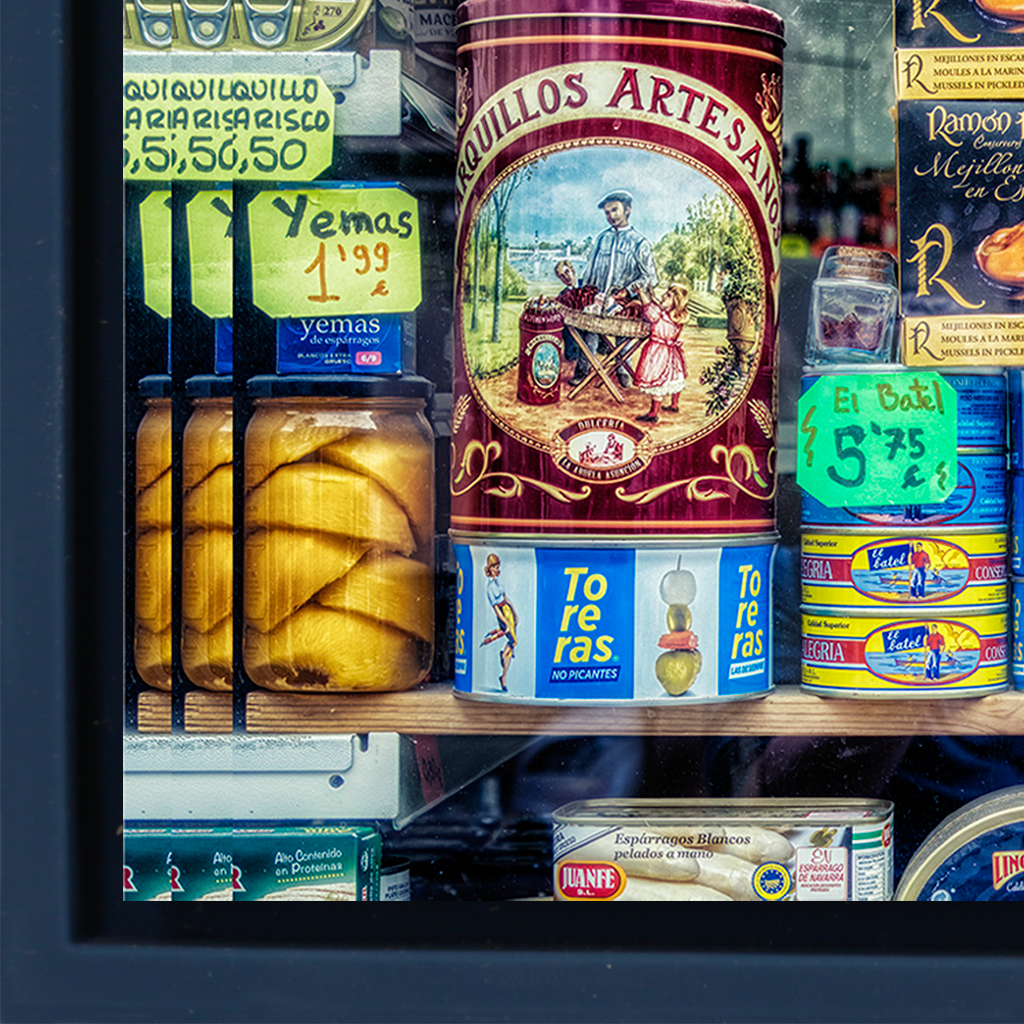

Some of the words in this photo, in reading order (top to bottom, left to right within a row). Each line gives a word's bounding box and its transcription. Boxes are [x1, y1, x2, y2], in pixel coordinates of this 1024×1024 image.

[965, 185, 989, 199] en
[272, 193, 413, 240] Yemas
[300, 318, 381, 341] yemas
[873, 553, 906, 569] batel
[563, 567, 608, 602] To
[559, 602, 601, 632] re
[888, 636, 922, 651] batel
[551, 668, 567, 680] NO
[568, 667, 618, 680] PICANTES
[614, 832, 695, 848] Espárragos
[697, 833, 751, 846] Blancos
[274, 851, 294, 864] Alto
[295, 849, 343, 863] Contenido
[614, 847, 664, 861] pelados
[666, 850, 676, 859] a
[677, 849, 714, 860] mano
[275, 867, 290, 875] en
[292, 862, 343, 875] Proteínas
[562, 866, 616, 890] JUANFE
